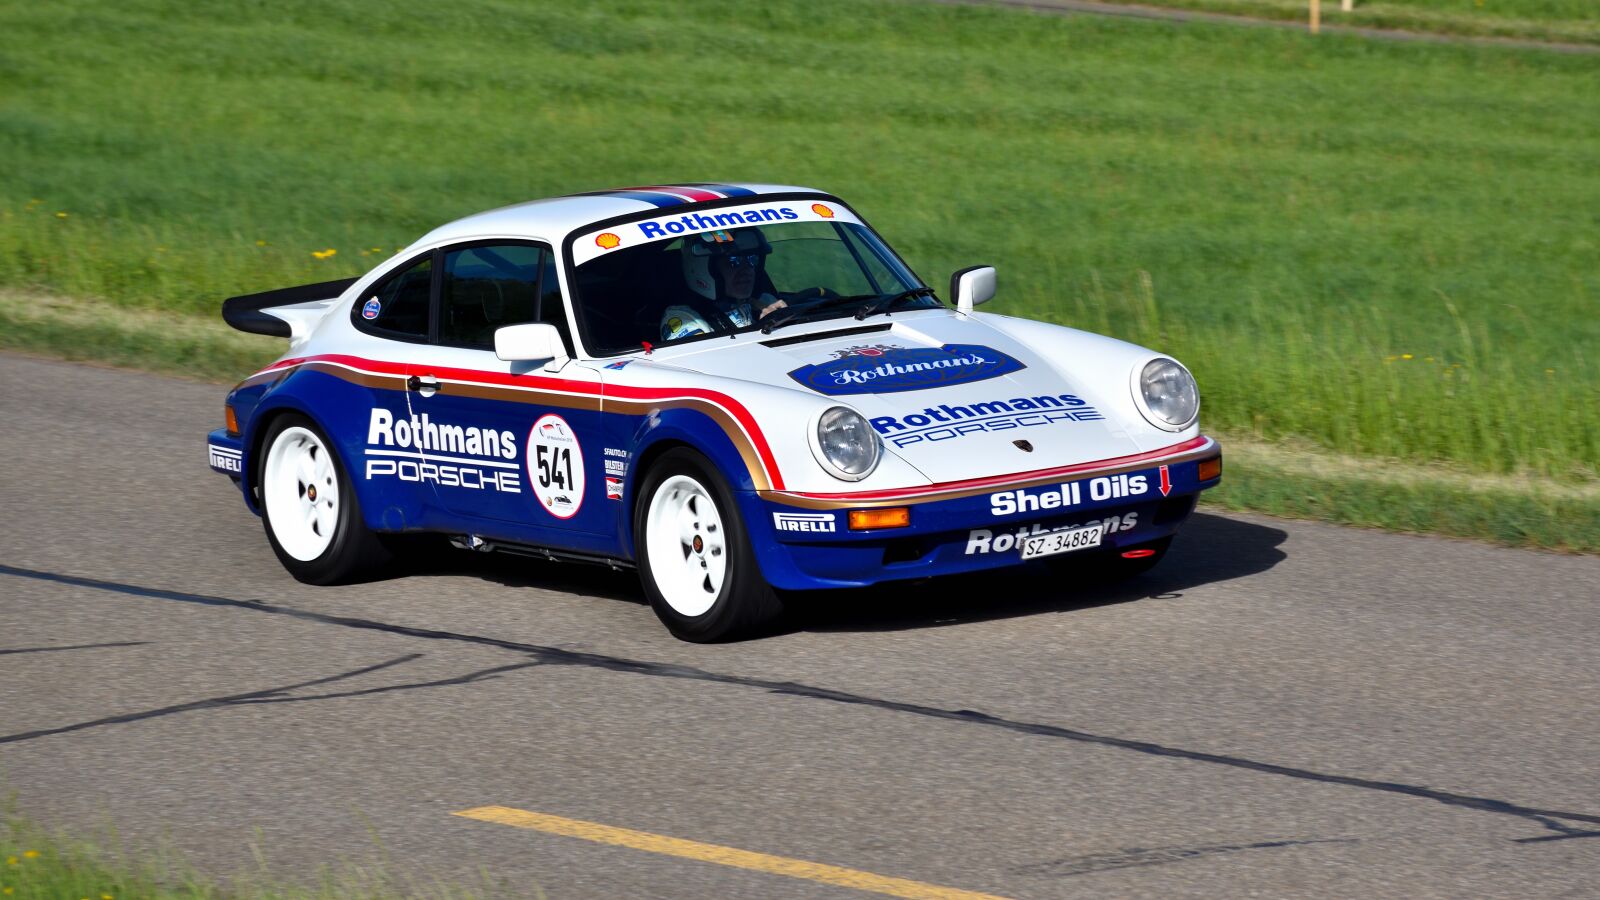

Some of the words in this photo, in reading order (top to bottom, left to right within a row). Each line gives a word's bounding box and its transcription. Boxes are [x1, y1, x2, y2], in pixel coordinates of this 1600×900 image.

[637, 204, 799, 239] Rothmans
[830, 353, 996, 385] Rothmans
[367, 407, 518, 460] Rothmans
[868, 394, 1086, 435] Rothmans
[892, 411, 1106, 449] PORSCHE
[208, 443, 243, 473] PIREL
[365, 459, 521, 493] PORSCHE
[536, 444, 574, 491] 541
[990, 482, 1081, 516] Shell
[1089, 474, 1149, 502] Oils
[772, 512, 836, 533] PIRELLI
[964, 511, 1139, 555] Rotns
